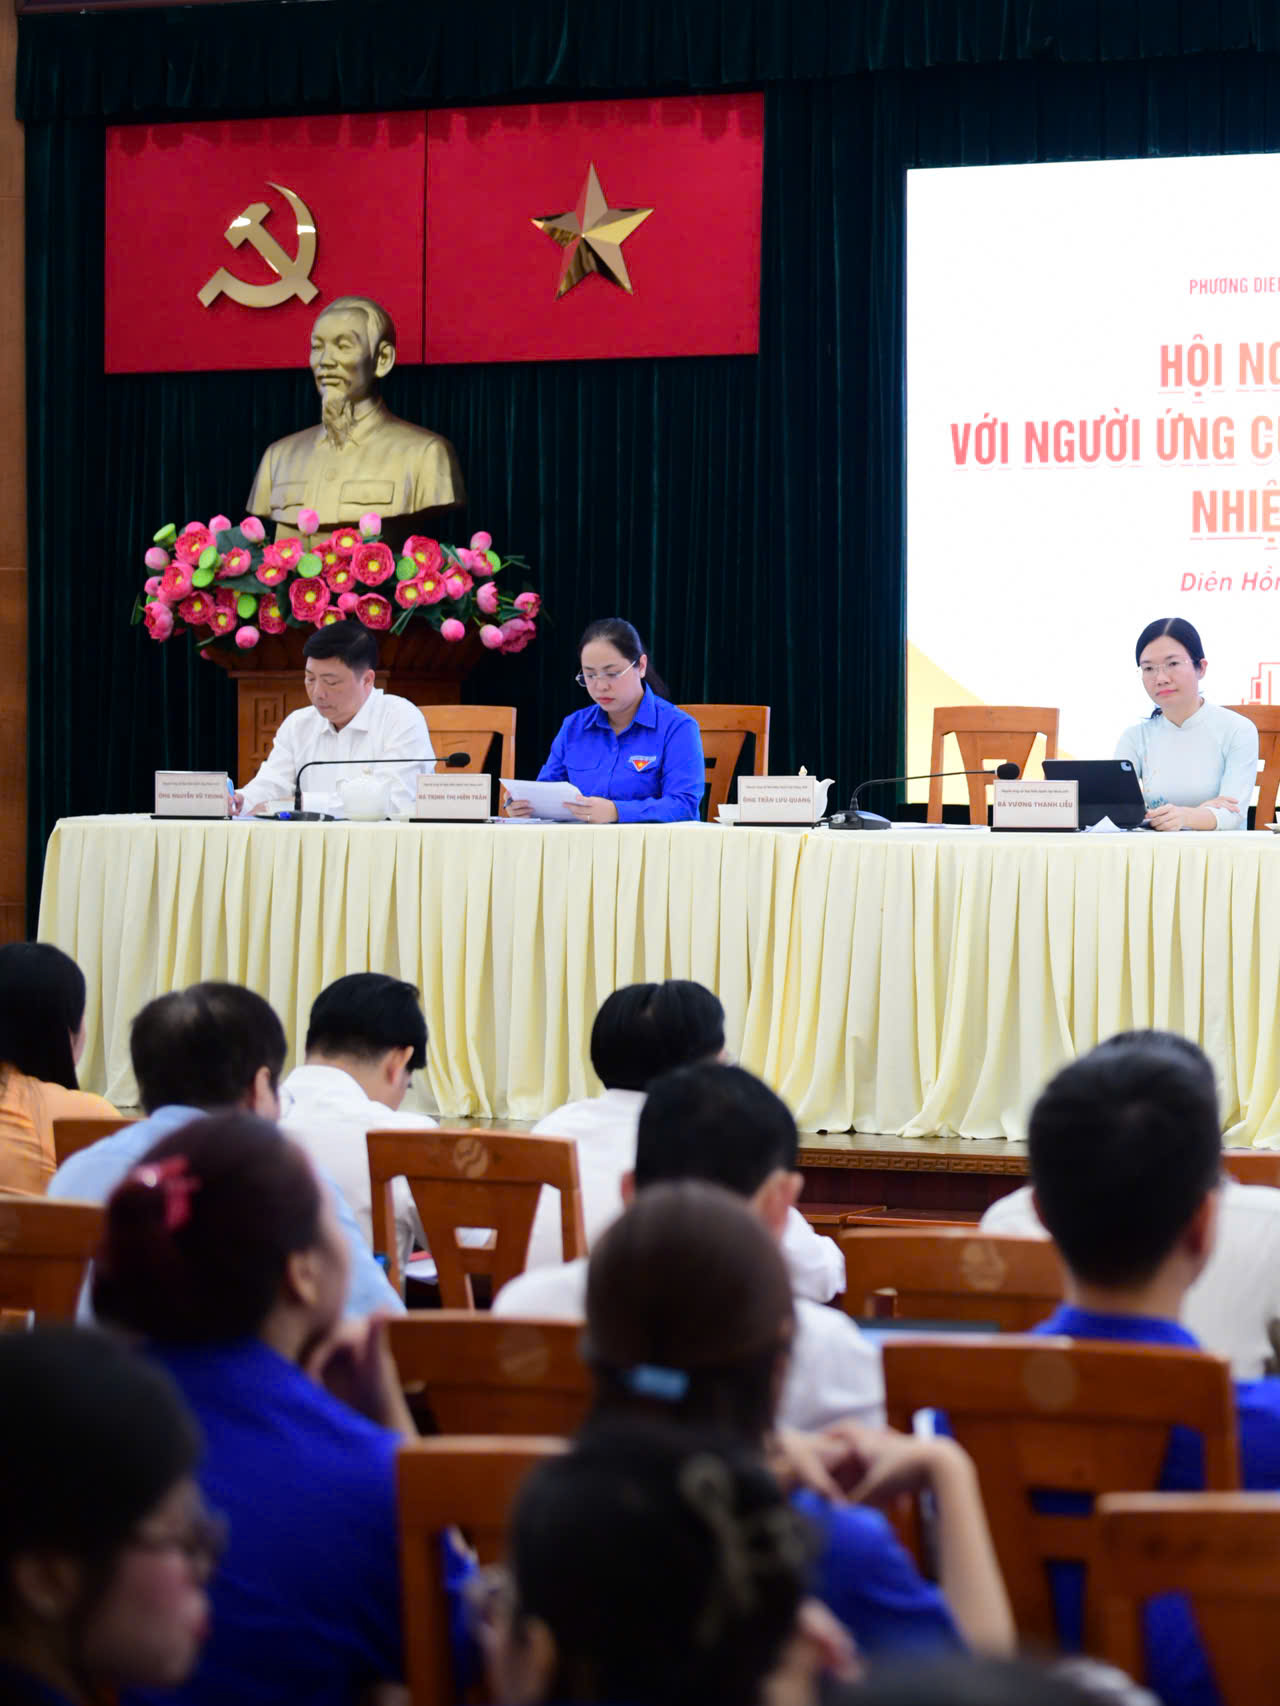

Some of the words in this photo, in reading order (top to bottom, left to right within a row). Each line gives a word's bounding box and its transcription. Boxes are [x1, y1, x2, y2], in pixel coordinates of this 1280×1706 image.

[1160, 334, 1223, 397] HỘI
[950, 412, 1009, 465] VỚI
[1025, 407, 1141, 463] NGƯỜI
[1156, 407, 1235, 461] ỨNG
[1180, 570, 1233, 592] Diên
